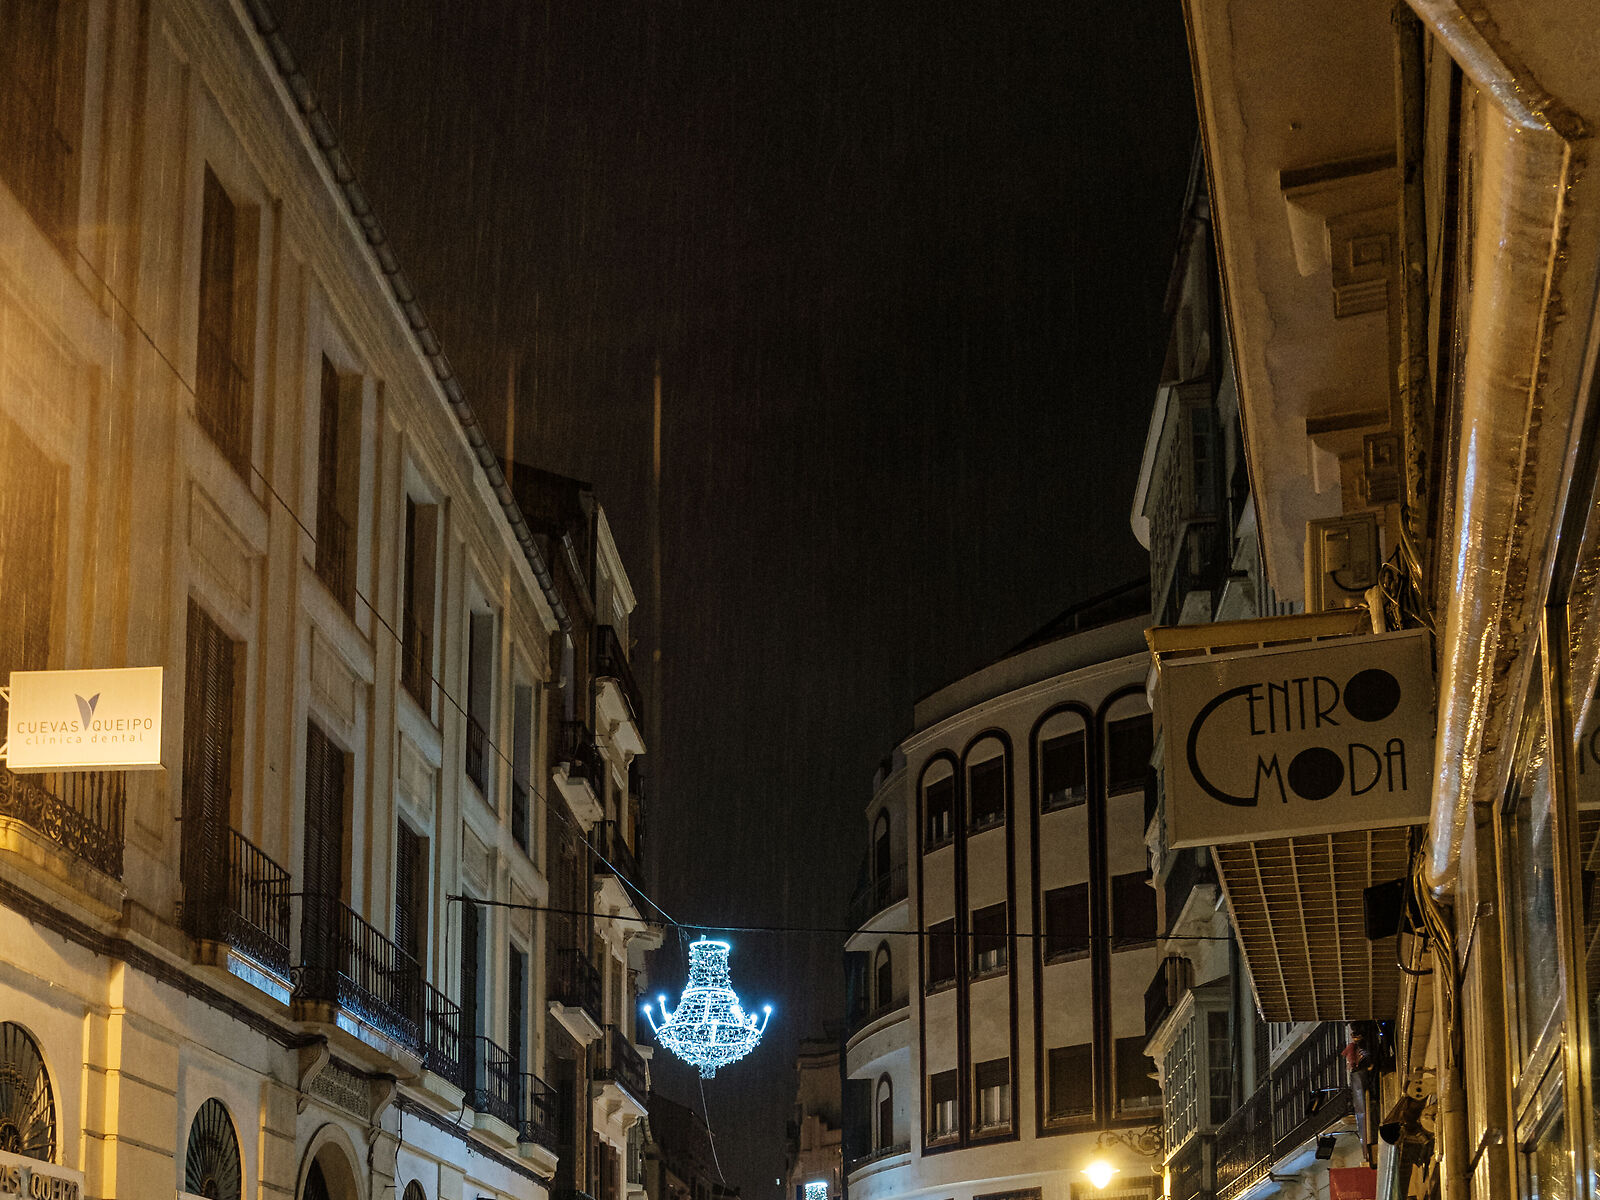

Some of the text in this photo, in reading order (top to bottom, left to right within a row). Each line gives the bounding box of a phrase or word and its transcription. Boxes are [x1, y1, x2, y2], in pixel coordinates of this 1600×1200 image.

[17, 718, 153, 734] CUEVAS QUEIPO
[91, 732, 144, 744] dental
[1255, 737, 1408, 804] MODA
